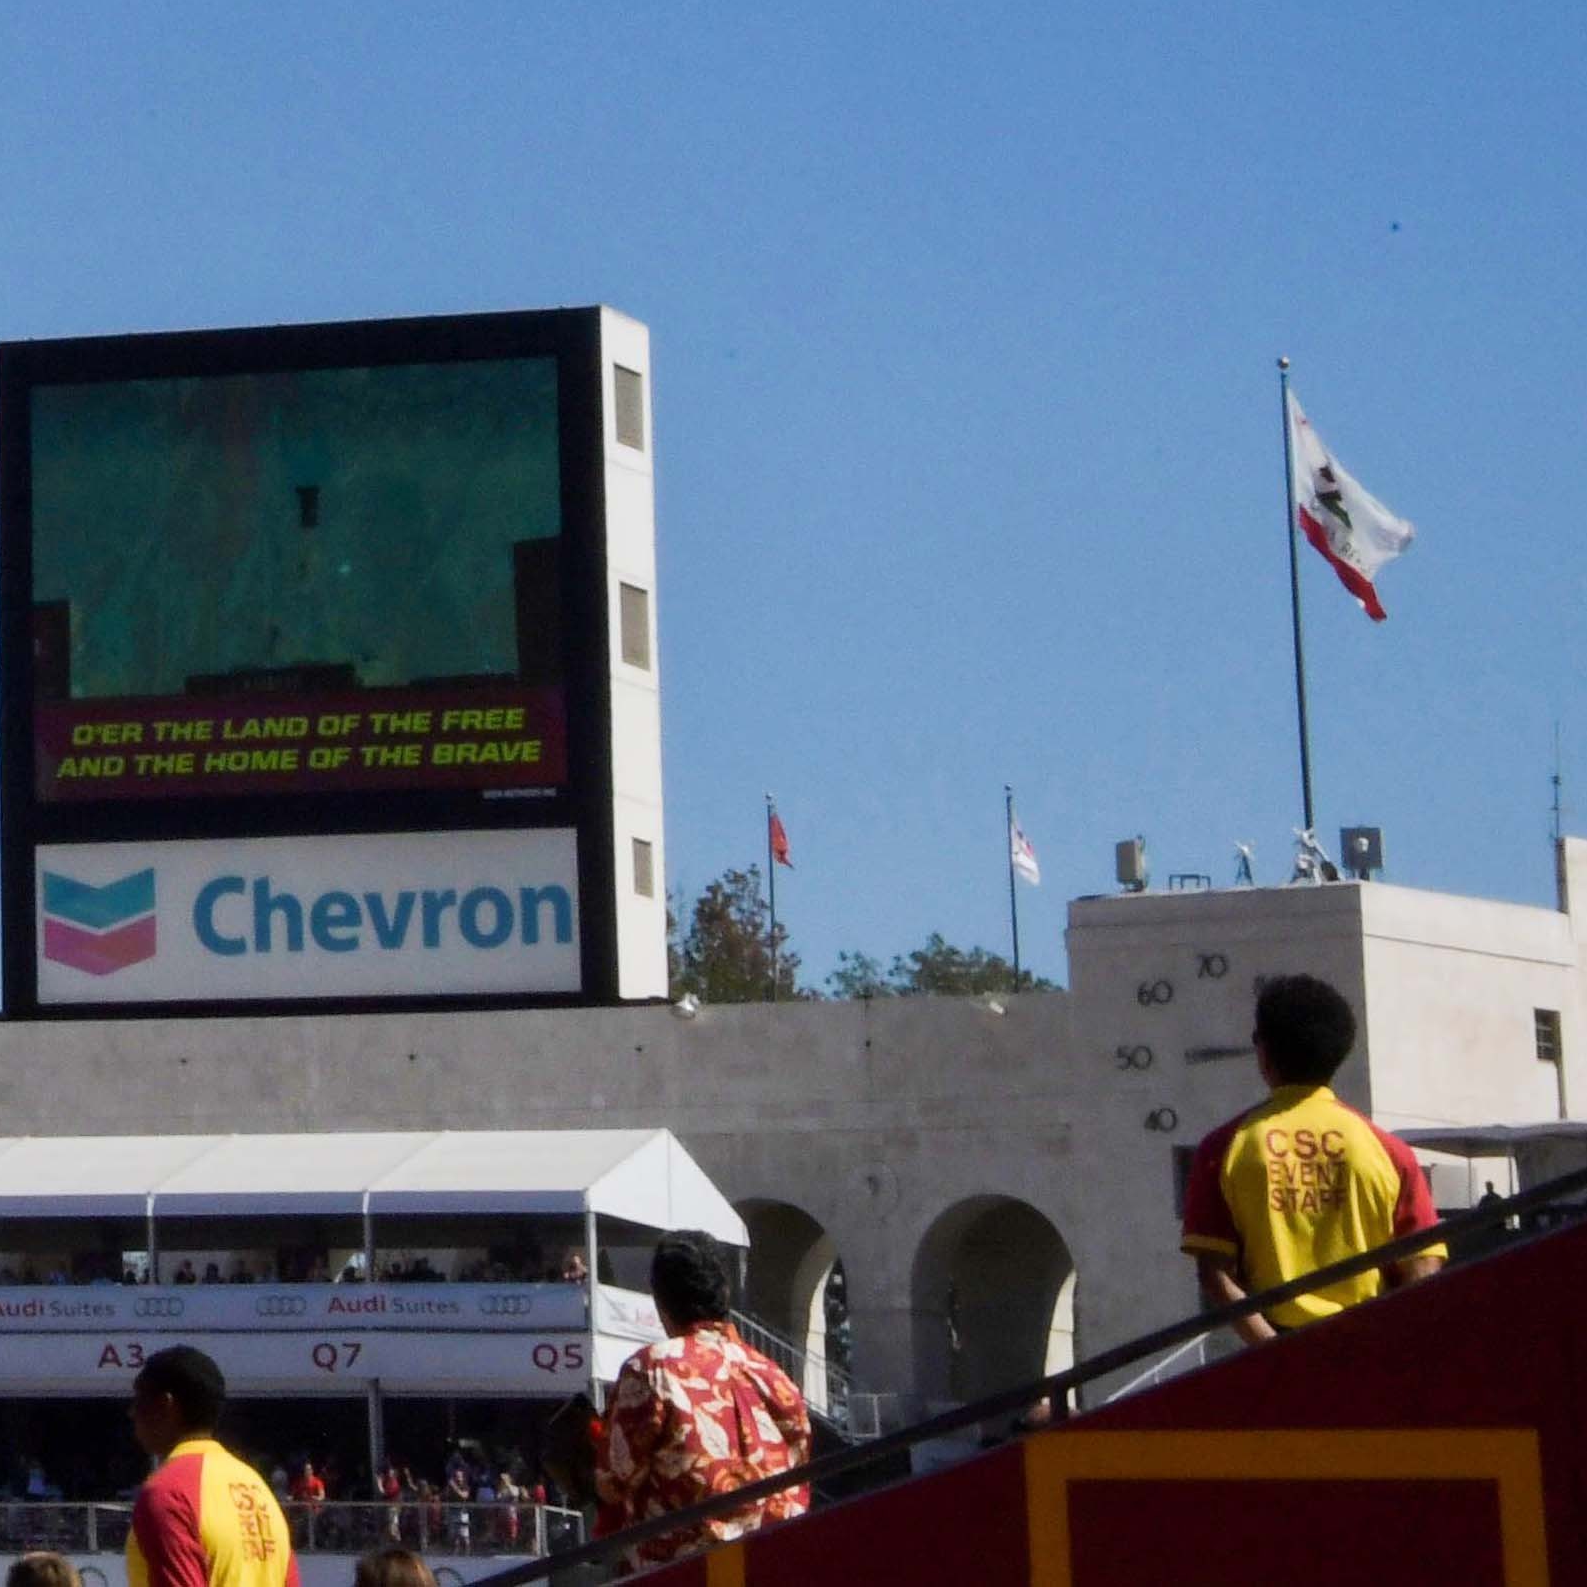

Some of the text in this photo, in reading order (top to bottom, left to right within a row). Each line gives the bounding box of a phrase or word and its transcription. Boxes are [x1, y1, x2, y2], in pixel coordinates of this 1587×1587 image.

[154, 721, 212, 743] THE
[222, 717, 308, 740] LAND
[316, 714, 367, 737] OF
[371, 712, 432, 734] THE
[441, 708, 526, 732] FREE
[57, 740, 542, 779] AND THE HOME OF THE BRAVE
[192, 872, 576, 959] Chevron
[1196, 953, 1228, 980] 70
[1136, 979, 1173, 1006] 60
[1115, 1044, 1153, 1071] 50
[1143, 1107, 1177, 1132] 40
[1265, 1128, 1346, 1160] CSC
[1267, 1160, 1346, 1186] EVENT
[1269, 1188, 1346, 1213] STAFF
[48, 1300, 116, 1318] Suites
[327, 1294, 460, 1315] Audi Suites
[97, 1342, 145, 1369] A3
[311, 1342, 362, 1373] Q7
[532, 1342, 585, 1373] Q5
